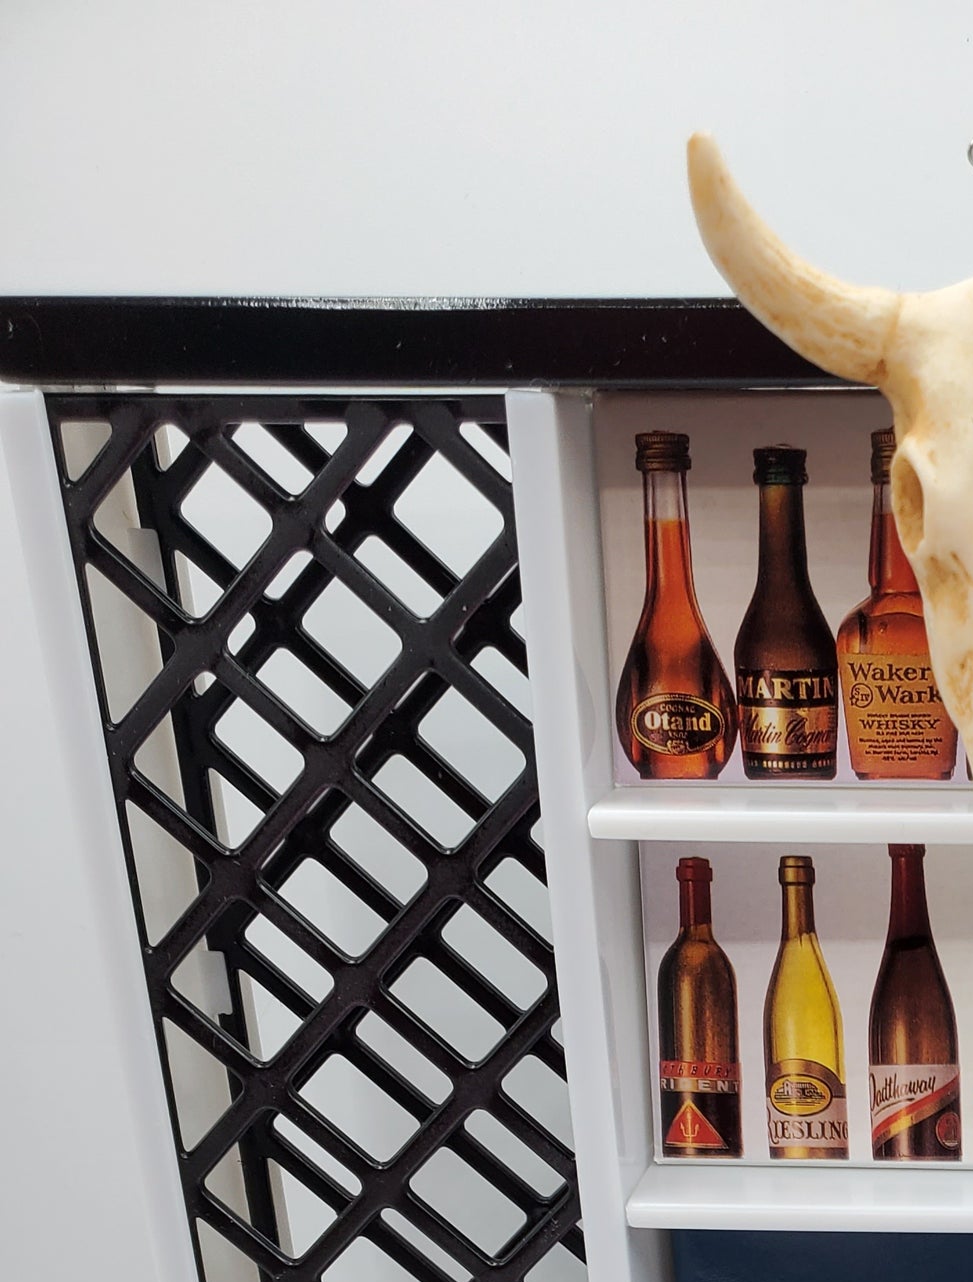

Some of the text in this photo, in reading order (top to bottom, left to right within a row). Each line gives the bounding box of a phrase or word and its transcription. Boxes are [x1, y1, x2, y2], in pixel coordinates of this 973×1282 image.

[847, 662, 932, 681] Waker
[875, 684, 943, 704] Wark
[644, 711, 712, 731] Otand
[859, 718, 940, 730] WHISKY
